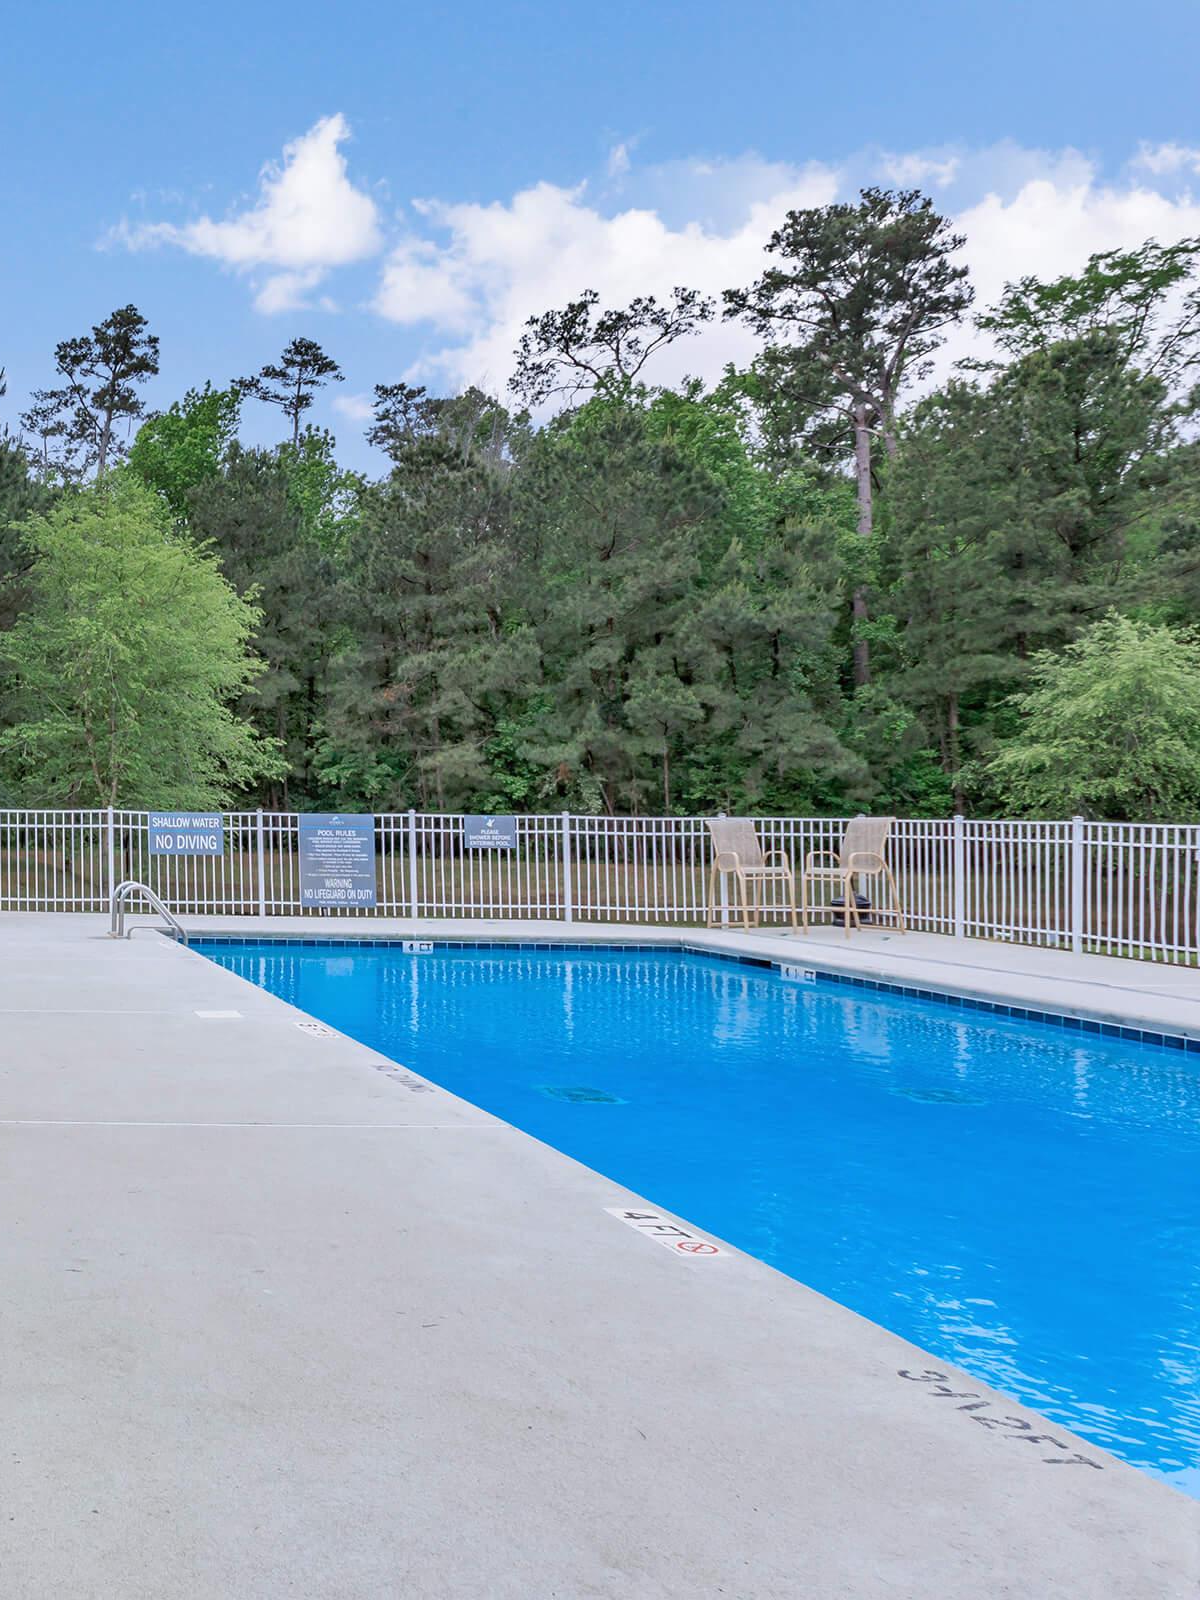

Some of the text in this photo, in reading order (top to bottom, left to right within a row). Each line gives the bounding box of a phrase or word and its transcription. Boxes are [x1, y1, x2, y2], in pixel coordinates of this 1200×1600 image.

[152, 817, 220, 828] SHALLOW WATER
[155, 834, 217, 850] NO DIVING
[325, 879, 353, 889] WARNING
[304, 888, 373, 900] NO LIFEGUARD ON DUTY
[623, 1211, 693, 1238] 4 FT
